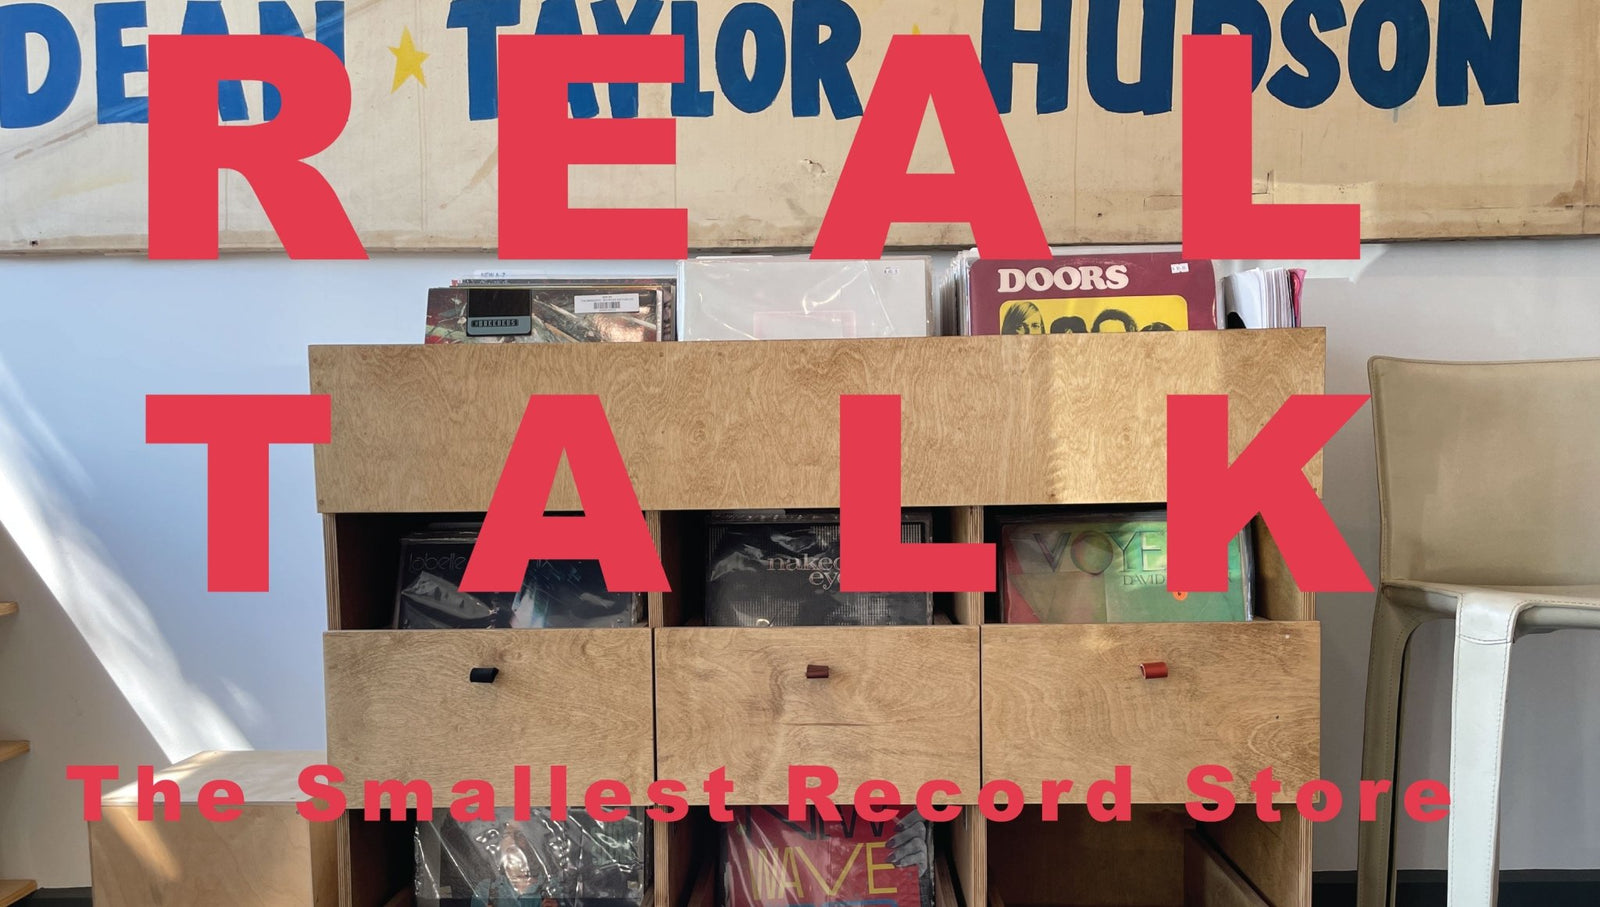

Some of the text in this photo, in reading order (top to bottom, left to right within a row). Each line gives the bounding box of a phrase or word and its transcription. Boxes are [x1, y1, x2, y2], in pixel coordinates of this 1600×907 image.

[998, 265, 1129, 293] DOORS
[409, 552, 466, 573] labelle
[1032, 530, 1167, 576] VOYE
[808, 571, 840, 590] ey
[1123, 574, 1165, 585] DAVID
[748, 841, 898, 900] WAVE
